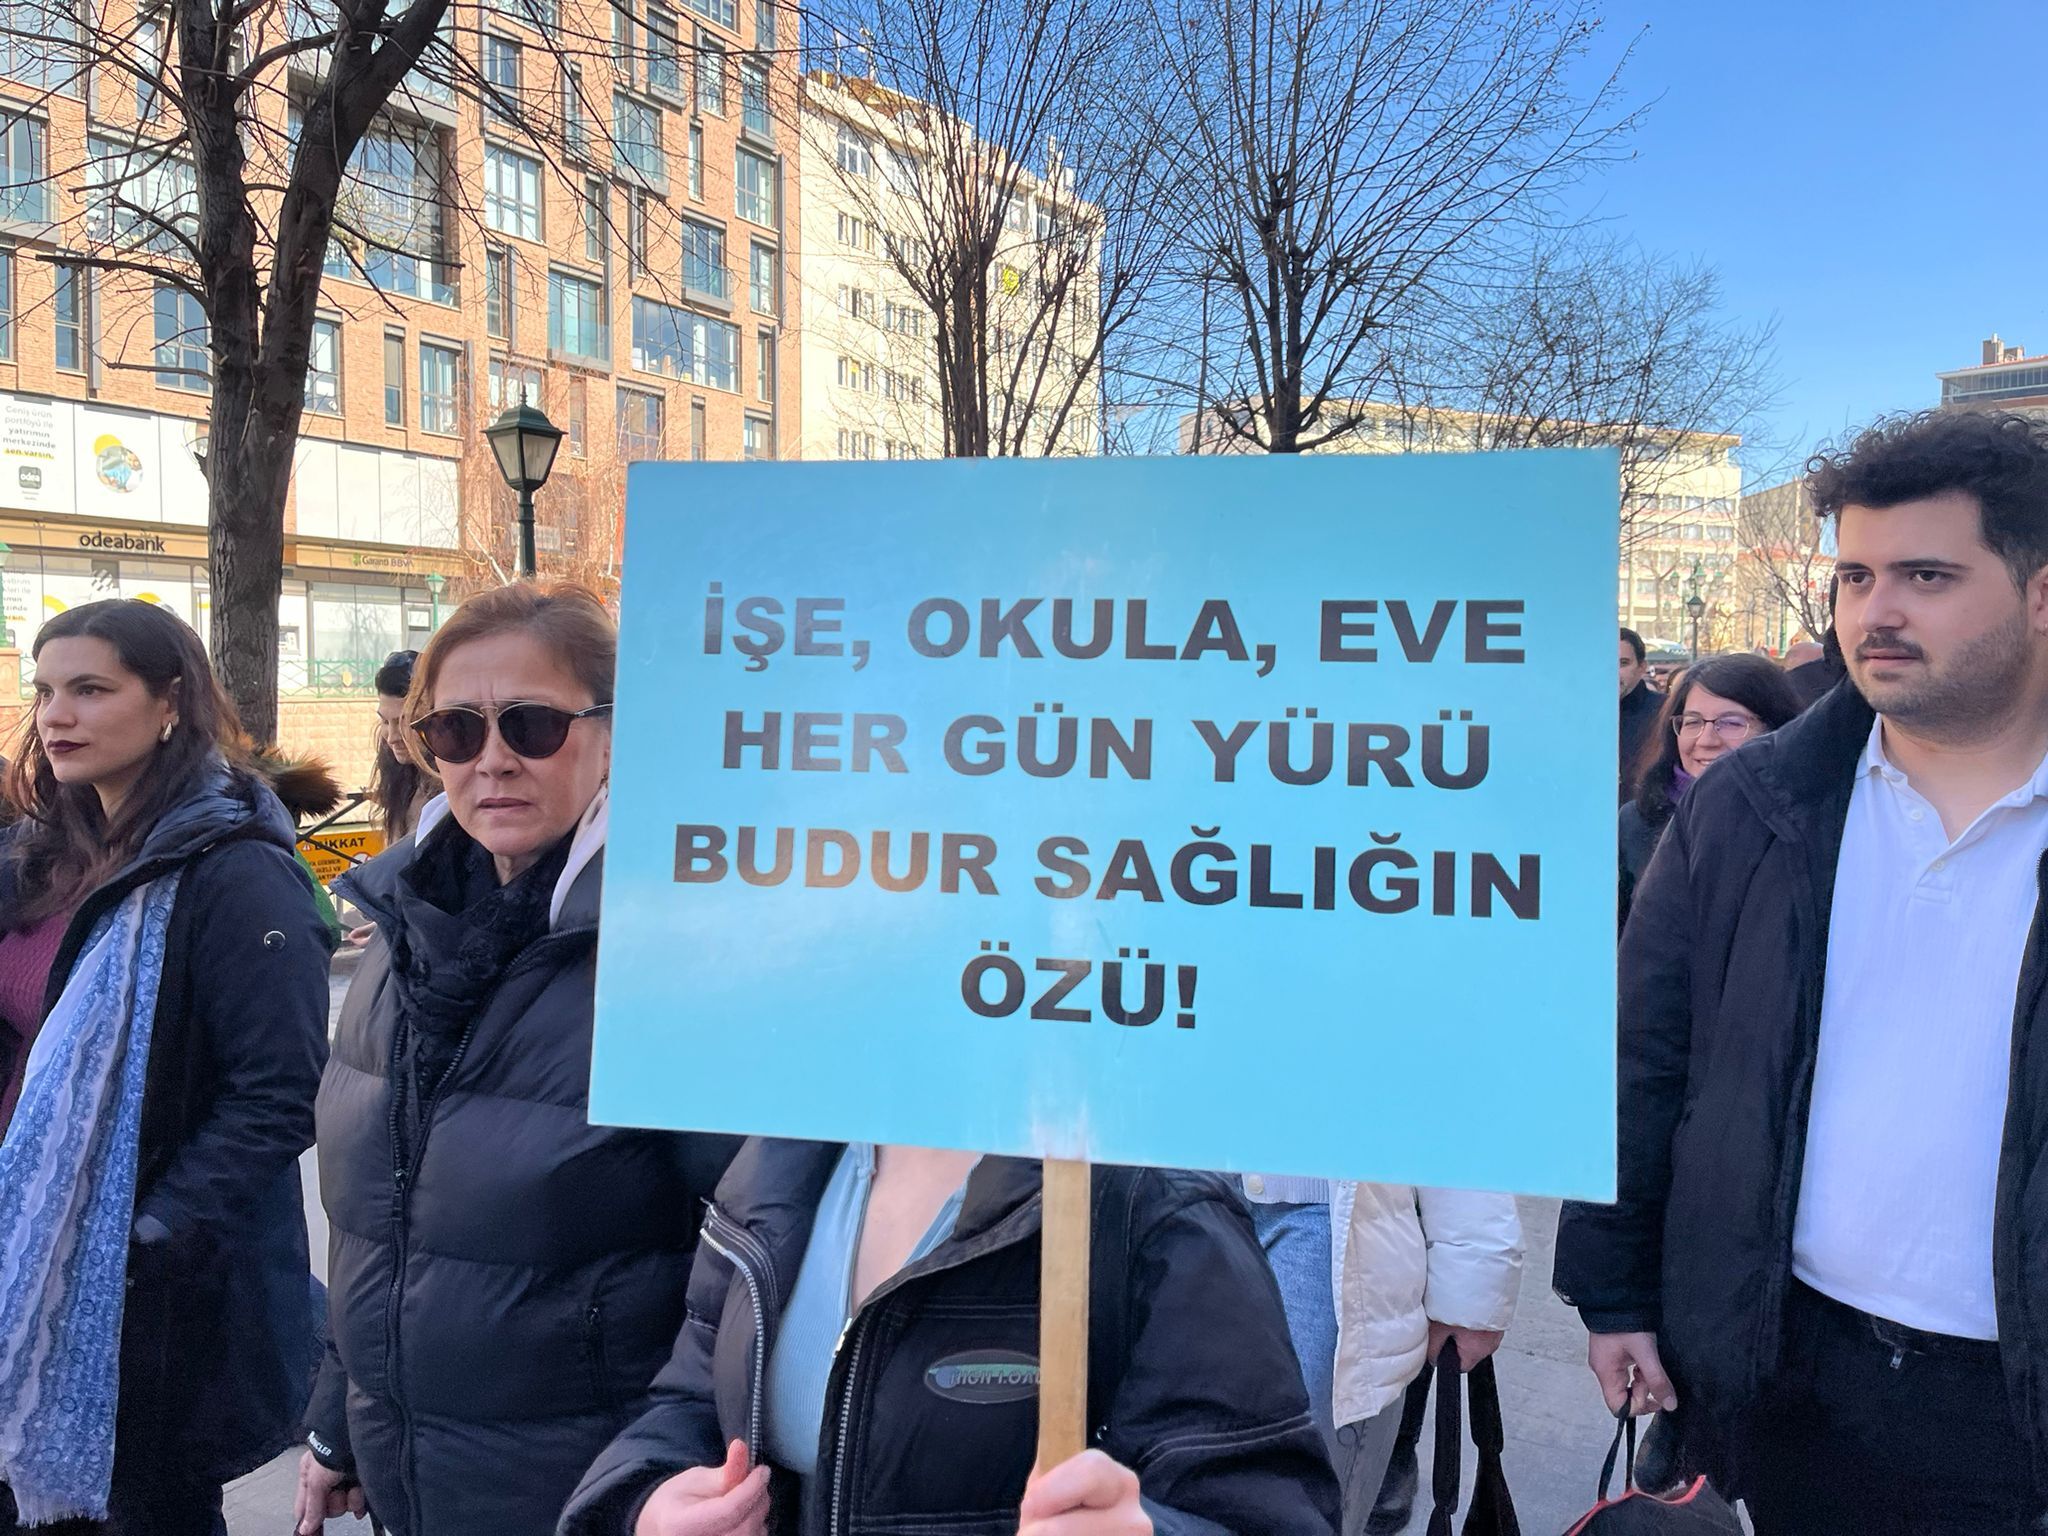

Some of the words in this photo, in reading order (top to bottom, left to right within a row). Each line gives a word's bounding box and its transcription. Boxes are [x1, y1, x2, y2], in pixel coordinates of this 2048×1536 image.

[2, 437, 56, 449] merkezinde
[80, 530, 165, 552] odeabank
[362, 555, 388, 566] Garanti
[391, 559, 414, 568] BBVA
[703, 581, 870, 671] İŞE,
[907, 597, 1277, 678] OKULA,
[1319, 599, 1526, 664] EVE
[723, 710, 909, 774] HER
[943, 702, 1153, 781] GÜN
[1191, 707, 1490, 791] YÜRÜ
[673, 823, 1000, 897] BUDUR
[1033, 825, 1541, 921] SAĞLIĞIN
[959, 940, 1199, 1030] ÖZÜ!
